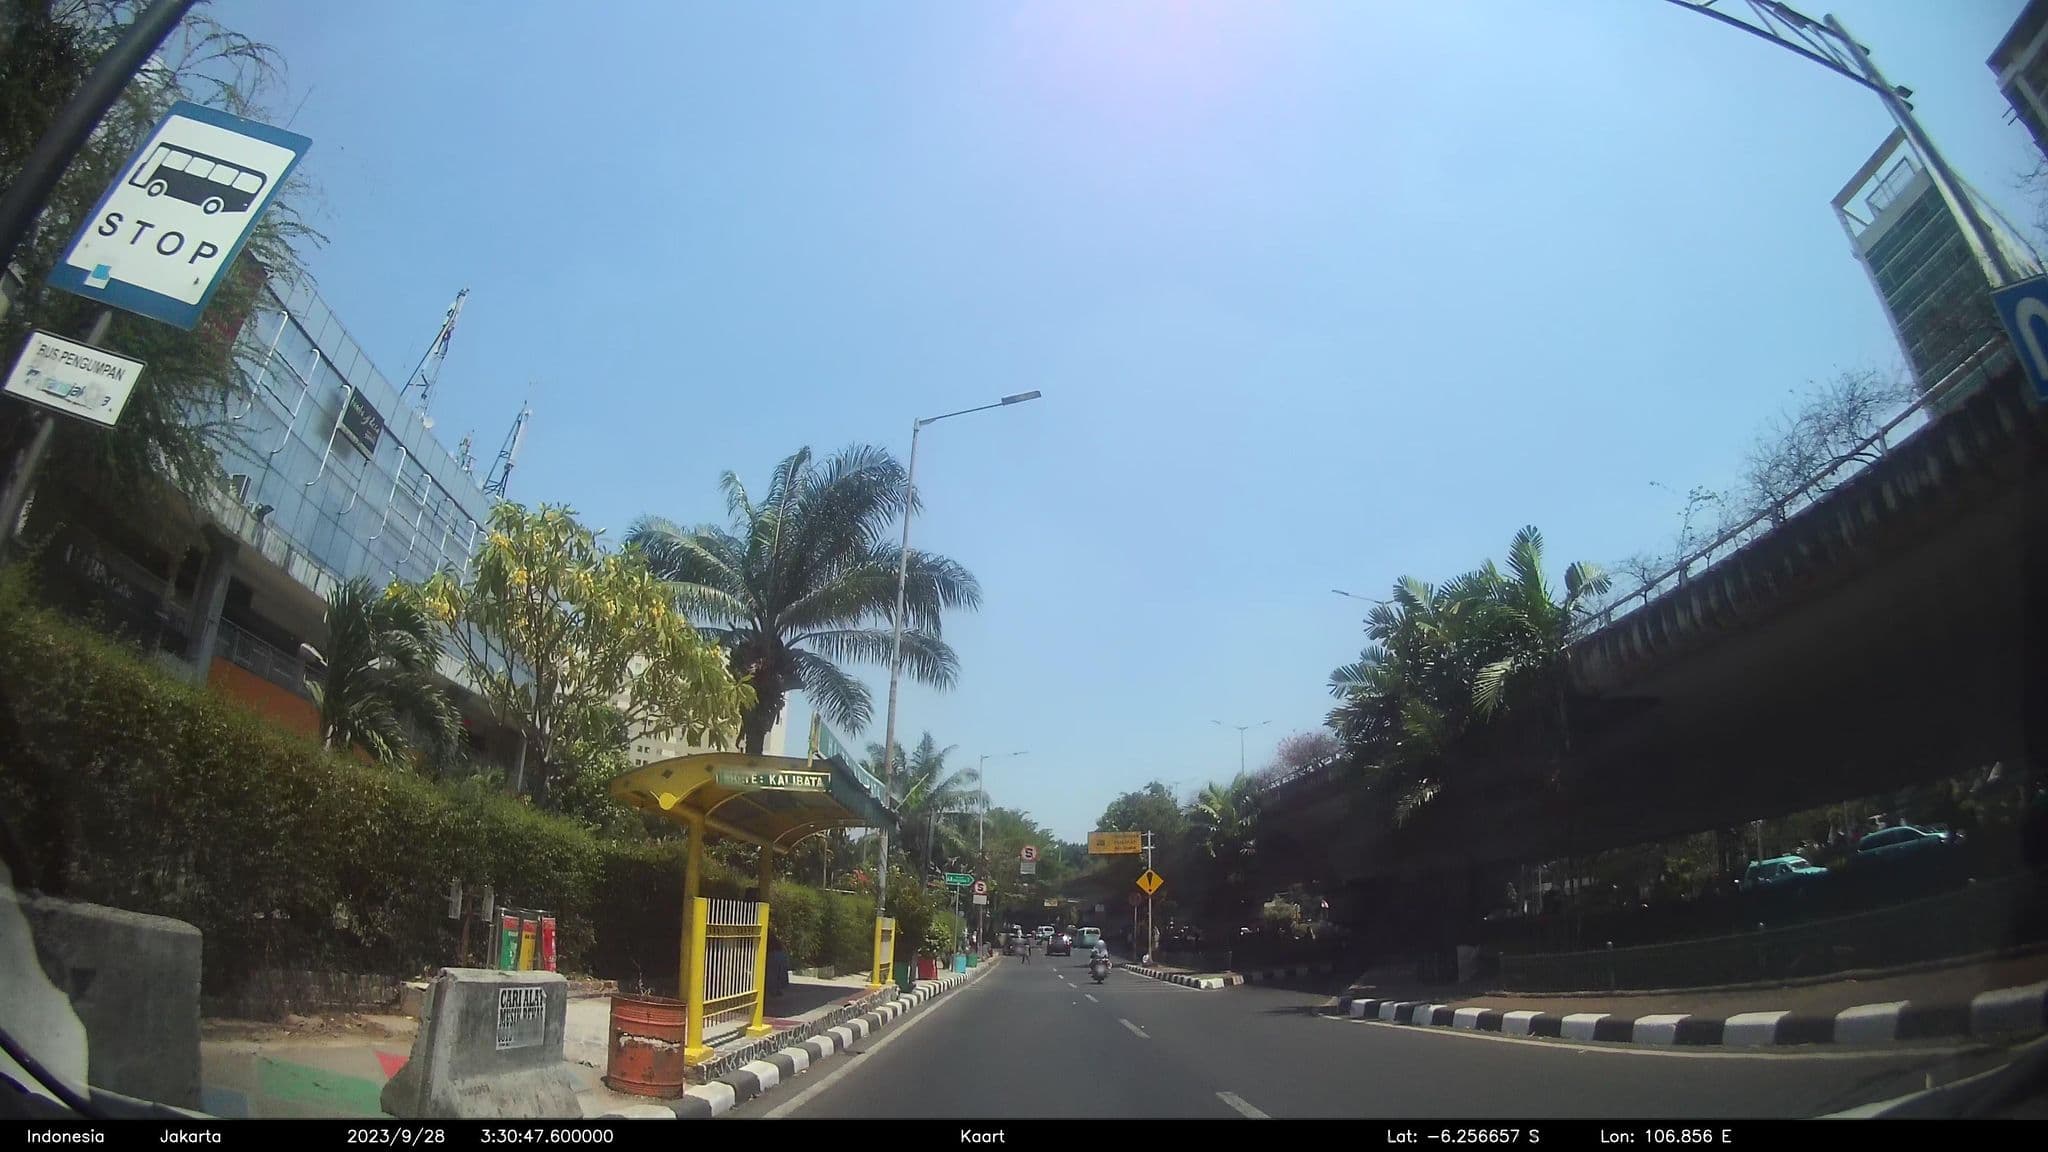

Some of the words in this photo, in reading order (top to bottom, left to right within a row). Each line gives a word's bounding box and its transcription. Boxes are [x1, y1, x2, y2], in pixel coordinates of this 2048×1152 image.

[98, 212, 219, 264] STOP
[38, 344, 60, 361] BUS
[60, 351, 126, 381] PENGUMPAN
[769, 774, 824, 788] KALIBATA
[500, 989, 522, 1008] CARI
[523, 989, 543, 1007] ALAT
